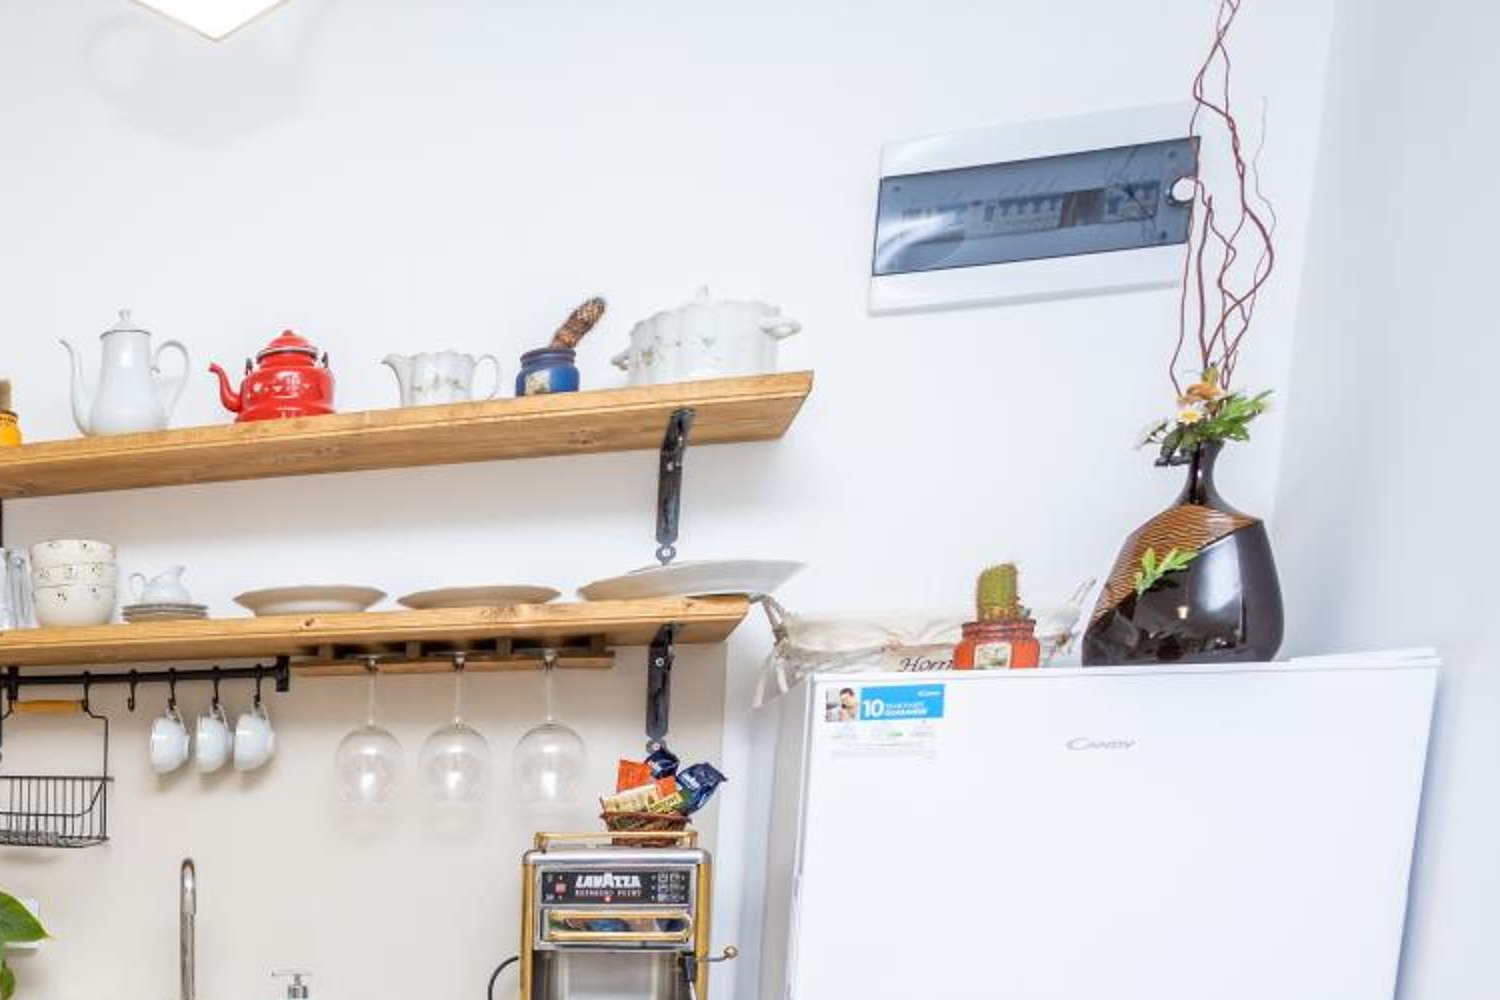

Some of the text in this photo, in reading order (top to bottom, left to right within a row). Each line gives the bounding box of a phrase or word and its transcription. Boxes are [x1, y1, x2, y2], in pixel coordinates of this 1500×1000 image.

[899, 656, 954, 673] Hom
[862, 699, 884, 718] 10
[575, 872, 642, 888] LAVAZZA
